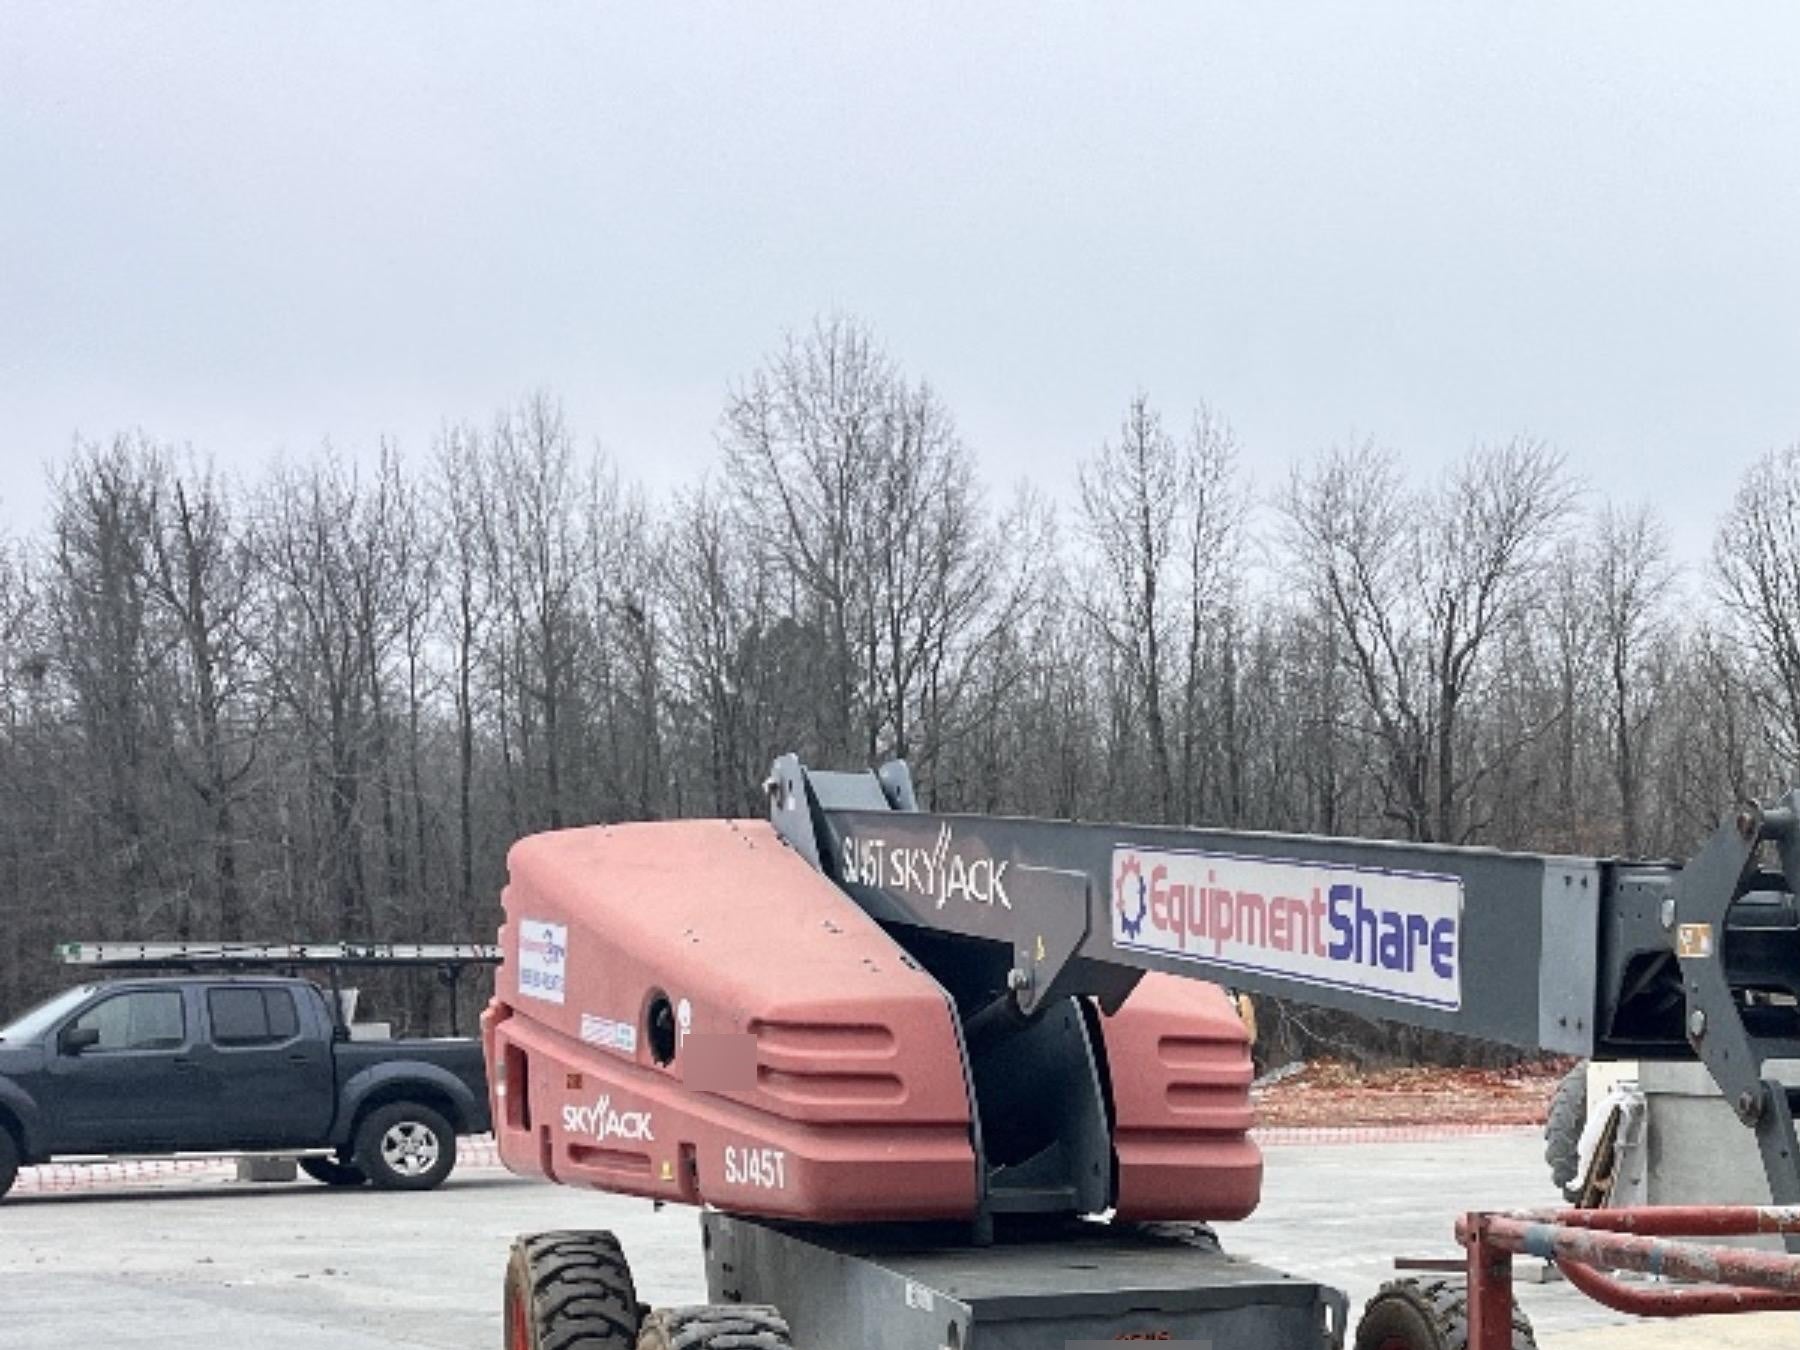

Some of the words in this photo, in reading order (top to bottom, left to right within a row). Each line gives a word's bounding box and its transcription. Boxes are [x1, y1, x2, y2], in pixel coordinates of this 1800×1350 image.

[890, 820, 1012, 910] SKYJACK
[1150, 864, 1456, 979] EquipmentShare
[562, 1094, 655, 1142] SKYJACK
[724, 1145, 786, 1190] SJ45T
